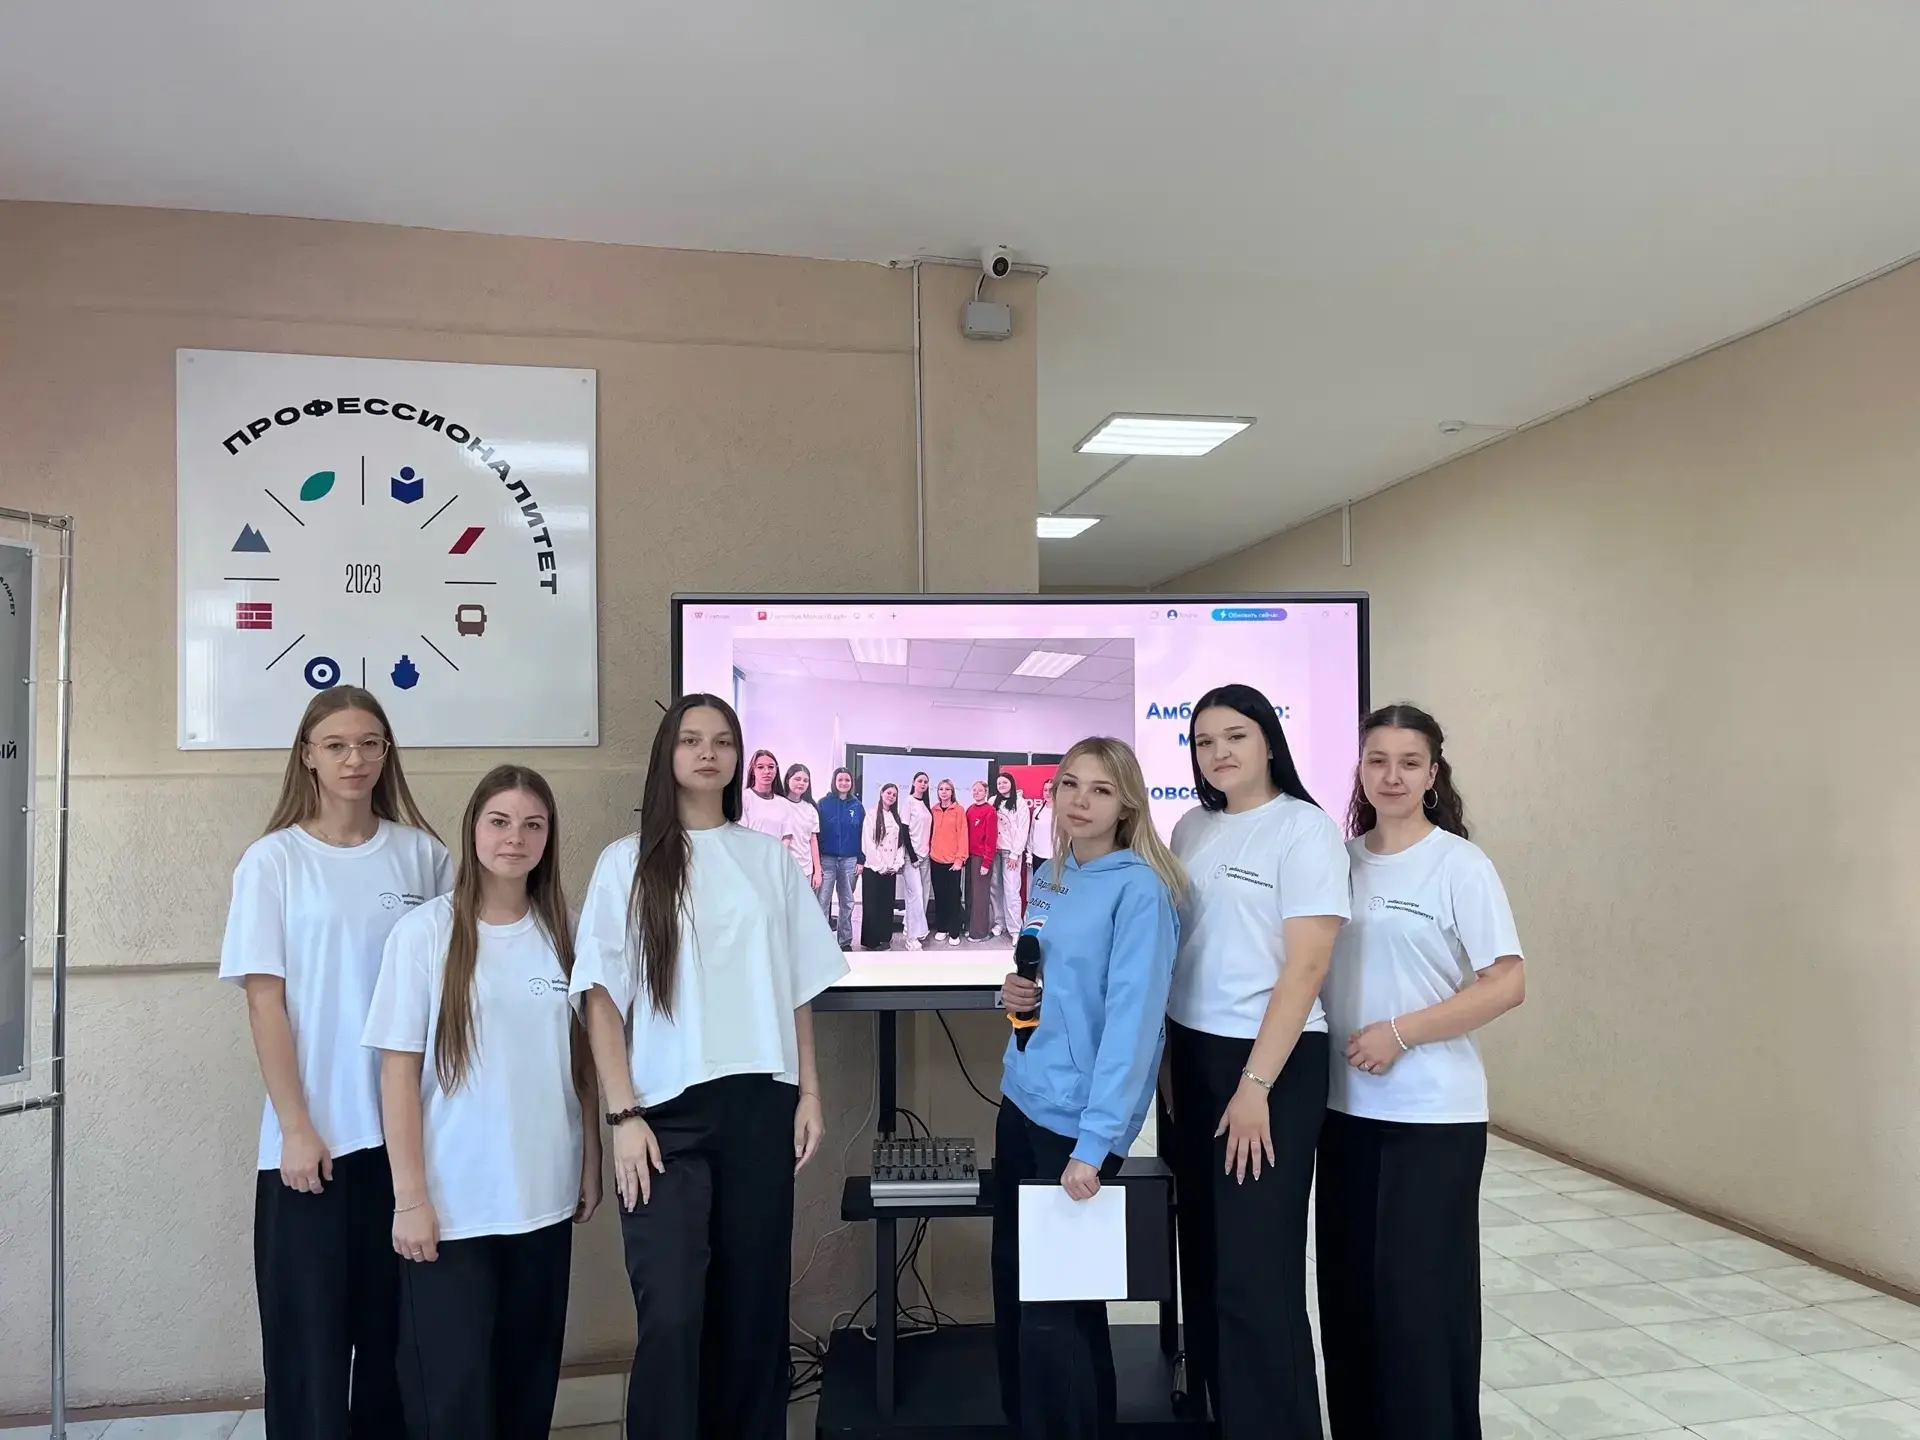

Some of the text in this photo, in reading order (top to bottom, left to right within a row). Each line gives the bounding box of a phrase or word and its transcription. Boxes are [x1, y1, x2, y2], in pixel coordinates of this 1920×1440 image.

[222, 397, 557, 594] ПРОФЕССИОНАЛИТЕТ
[345, 564, 381, 593] 2023
[1228, 611, 1257, 619] Обновить
